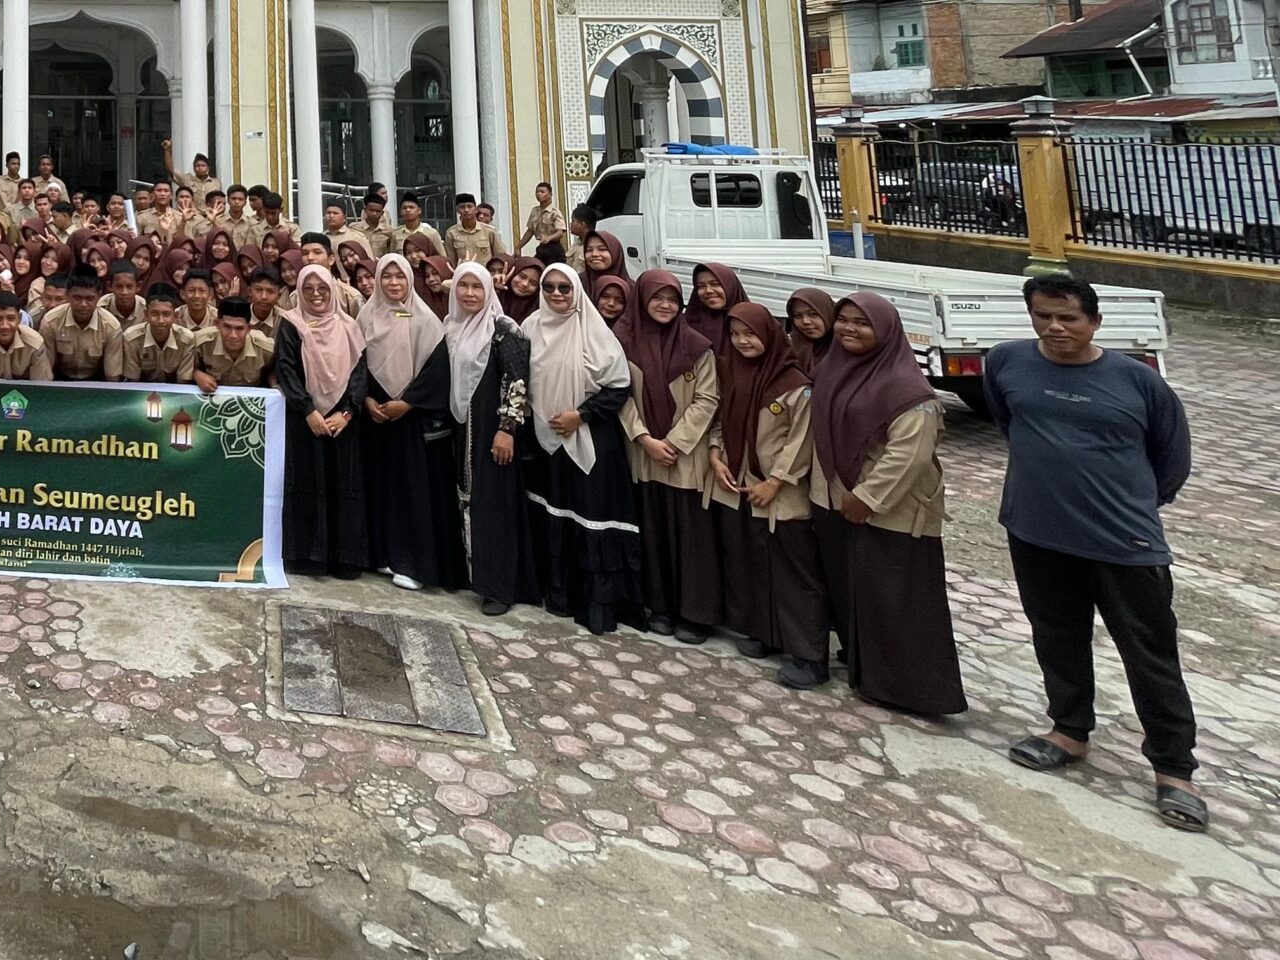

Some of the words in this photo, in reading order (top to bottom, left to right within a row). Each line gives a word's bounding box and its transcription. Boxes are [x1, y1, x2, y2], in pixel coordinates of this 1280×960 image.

[16, 429, 160, 460] Ramadhan
[33, 482, 196, 520] Seumeugleh
[17, 512, 84, 533] BARAT
[89, 517, 143, 539] DAYA
[1, 537, 21, 547] suci
[24, 538, 78, 551] Ramadhan
[81, 543, 103, 553] 1447
[105, 544, 145, 558] Hijriah,
[15, 548, 33, 559] diri
[36, 550, 60, 560] lahir
[62, 552, 81, 562] dan
[84, 554, 110, 565] batin
